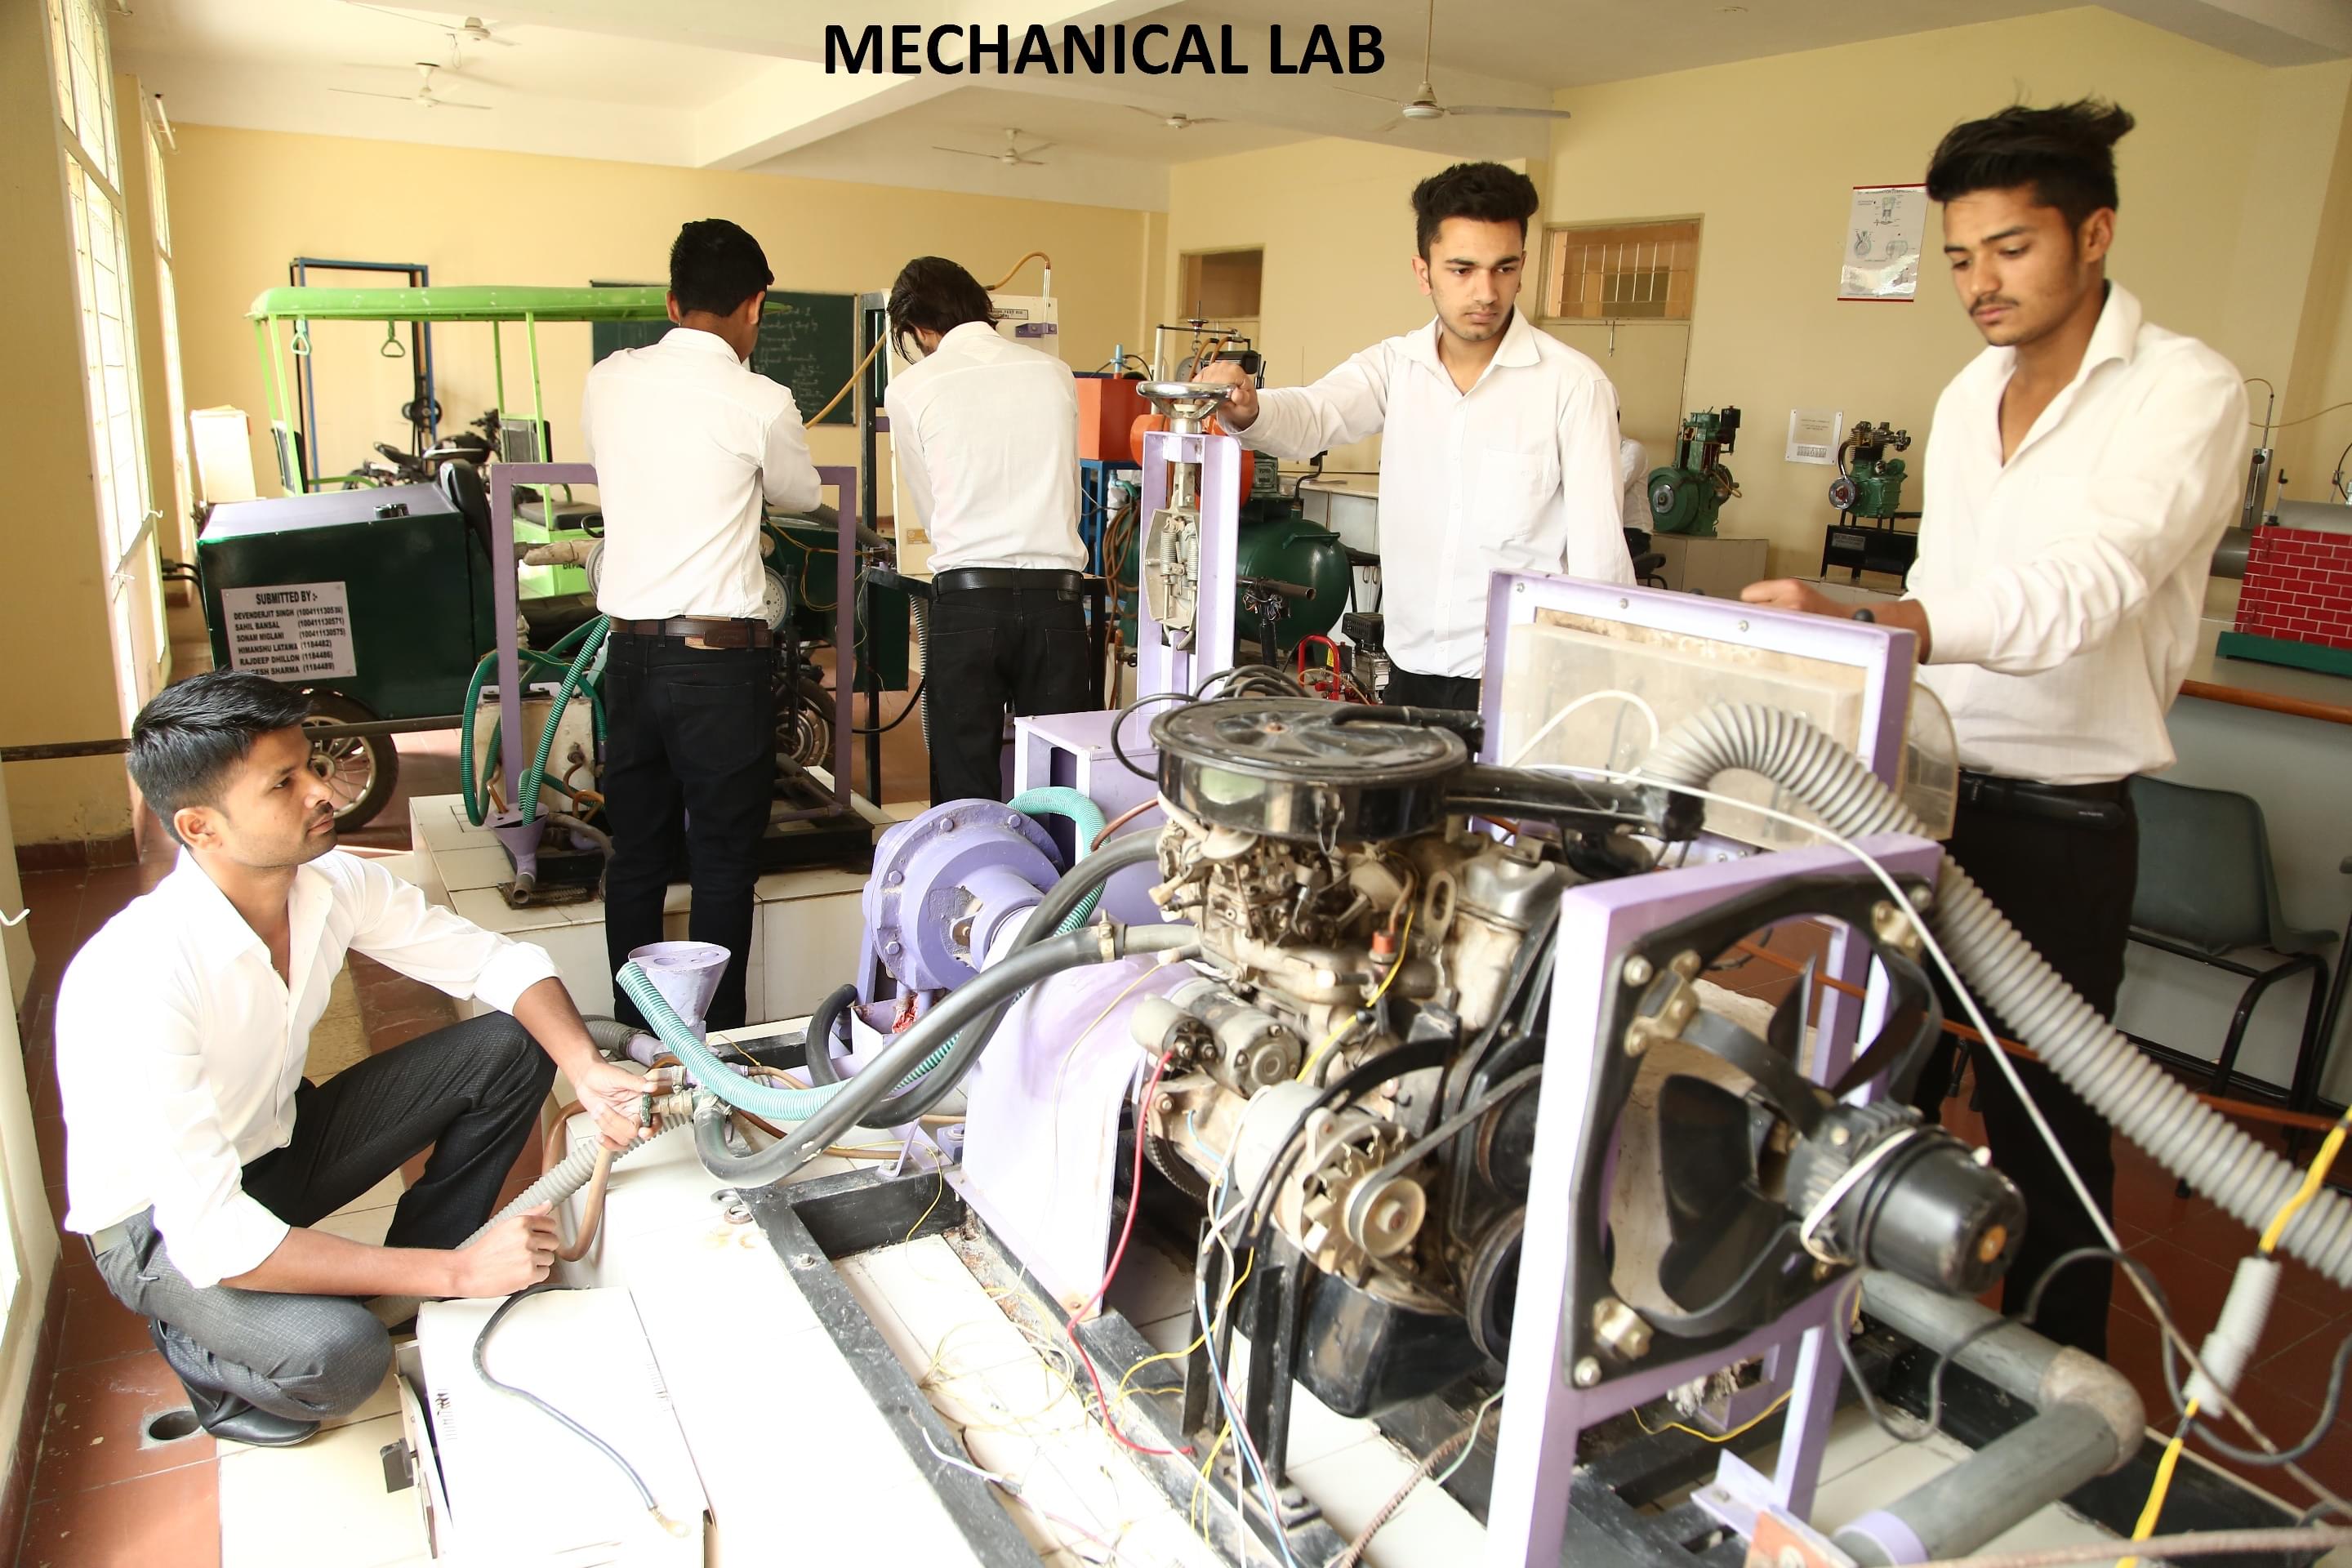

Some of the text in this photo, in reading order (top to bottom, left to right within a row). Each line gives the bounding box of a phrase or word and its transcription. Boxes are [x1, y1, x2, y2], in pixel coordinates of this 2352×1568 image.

[256, 591, 300, 605] SUBMITTED
[234, 610, 274, 620] DEVENDERJIT
[275, 608, 295, 617] SINGH
[235, 622, 254, 631] SAHIL
[255, 621, 280, 630] BANSAL
[237, 634, 258, 643] SONAM
[259, 632, 284, 640] MIGLANI
[238, 645, 272, 654] HIMANSHU
[239, 657, 270, 666] RAJDEEP
[271, 654, 300, 663] DHILLON
[271, 666, 300, 675] SHARMA
